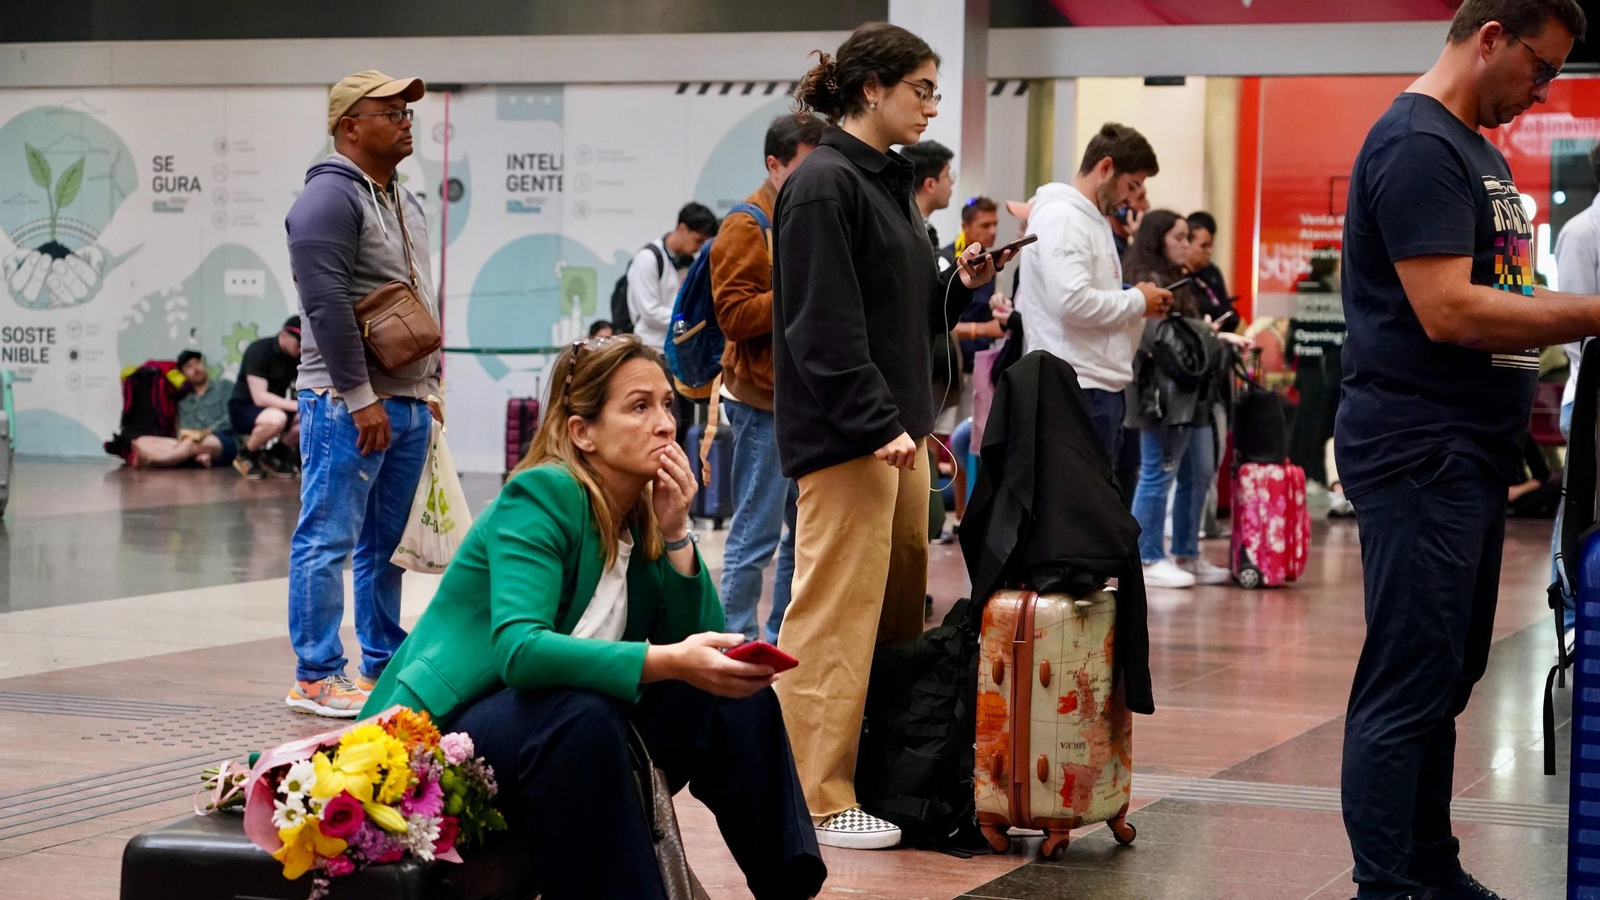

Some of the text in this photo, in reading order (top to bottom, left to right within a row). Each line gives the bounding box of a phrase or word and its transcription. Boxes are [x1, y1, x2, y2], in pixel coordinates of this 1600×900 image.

[152, 155, 175, 173] SE
[506, 153, 564, 171] INTELI
[152, 175, 202, 194] GURA
[1299, 212, 1334, 226] Venta
[2, 326, 57, 344] SOSTE
[1294, 329, 1342, 346] Opening
[2, 346, 50, 364] NIBLE
[1293, 343, 1324, 357] from
